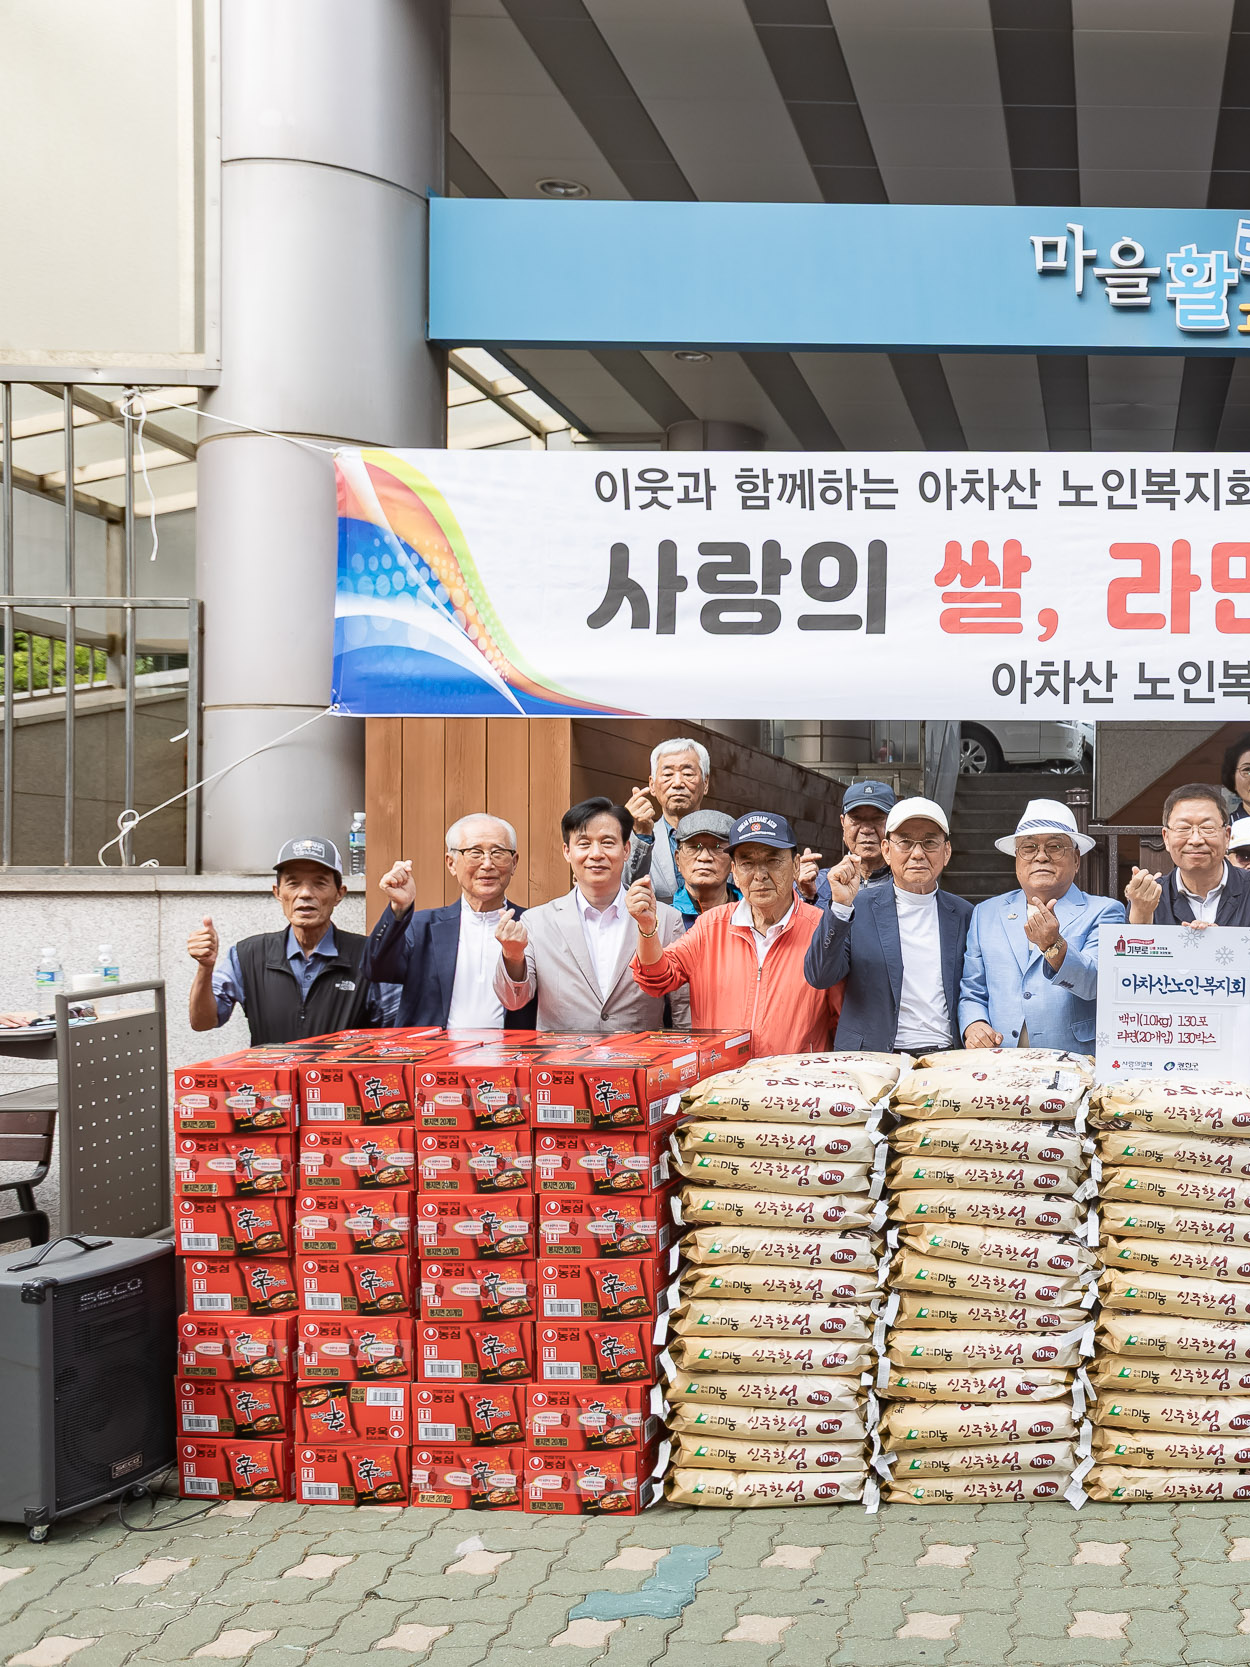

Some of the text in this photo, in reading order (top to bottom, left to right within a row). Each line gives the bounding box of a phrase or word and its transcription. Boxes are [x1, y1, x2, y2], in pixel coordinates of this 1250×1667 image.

[596, 468, 716, 510] 이웃과
[735, 468, 898, 510] 함께하는
[919, 469, 1040, 510] 아차산
[587, 540, 887, 634] 사랑의
[935, 539, 1058, 641] 쌀,
[993, 661, 1117, 704] 아차산
[1127, 945, 1149, 954] 기부로
[1121, 973, 1247, 998] 아차산노인복지회
[321, 1072, 343, 1082] 농심
[437, 1075, 458, 1085] 농심
[552, 1075, 574, 1085] 농심
[438, 1330, 460, 1339] 농심
[547, 1395, 569, 1405] 농심
[315, 1452, 338, 1462] 농심
